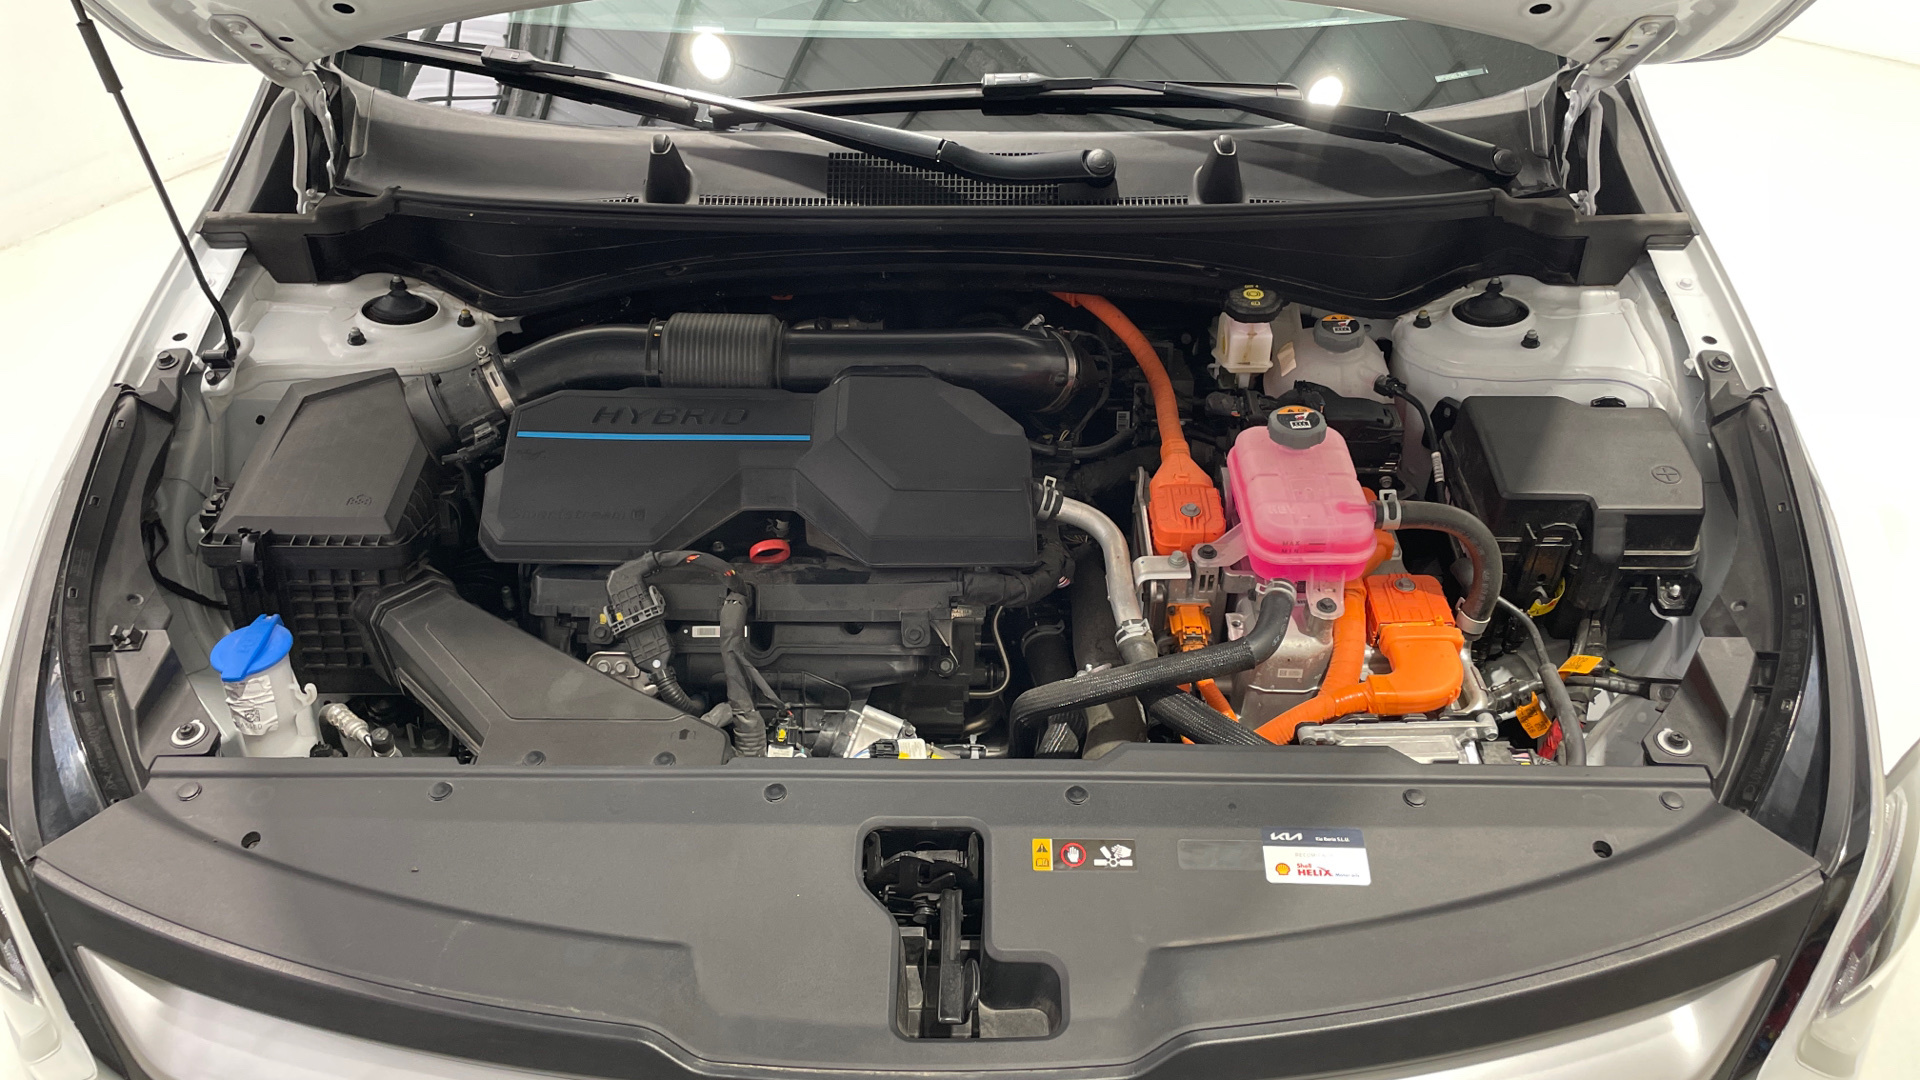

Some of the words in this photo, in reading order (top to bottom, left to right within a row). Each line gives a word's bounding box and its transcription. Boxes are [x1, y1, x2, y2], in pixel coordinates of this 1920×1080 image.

[591, 406, 749, 424] HYBRID
[1270, 832, 1303, 841] KIA
[1297, 867, 1333, 877] HELIX
